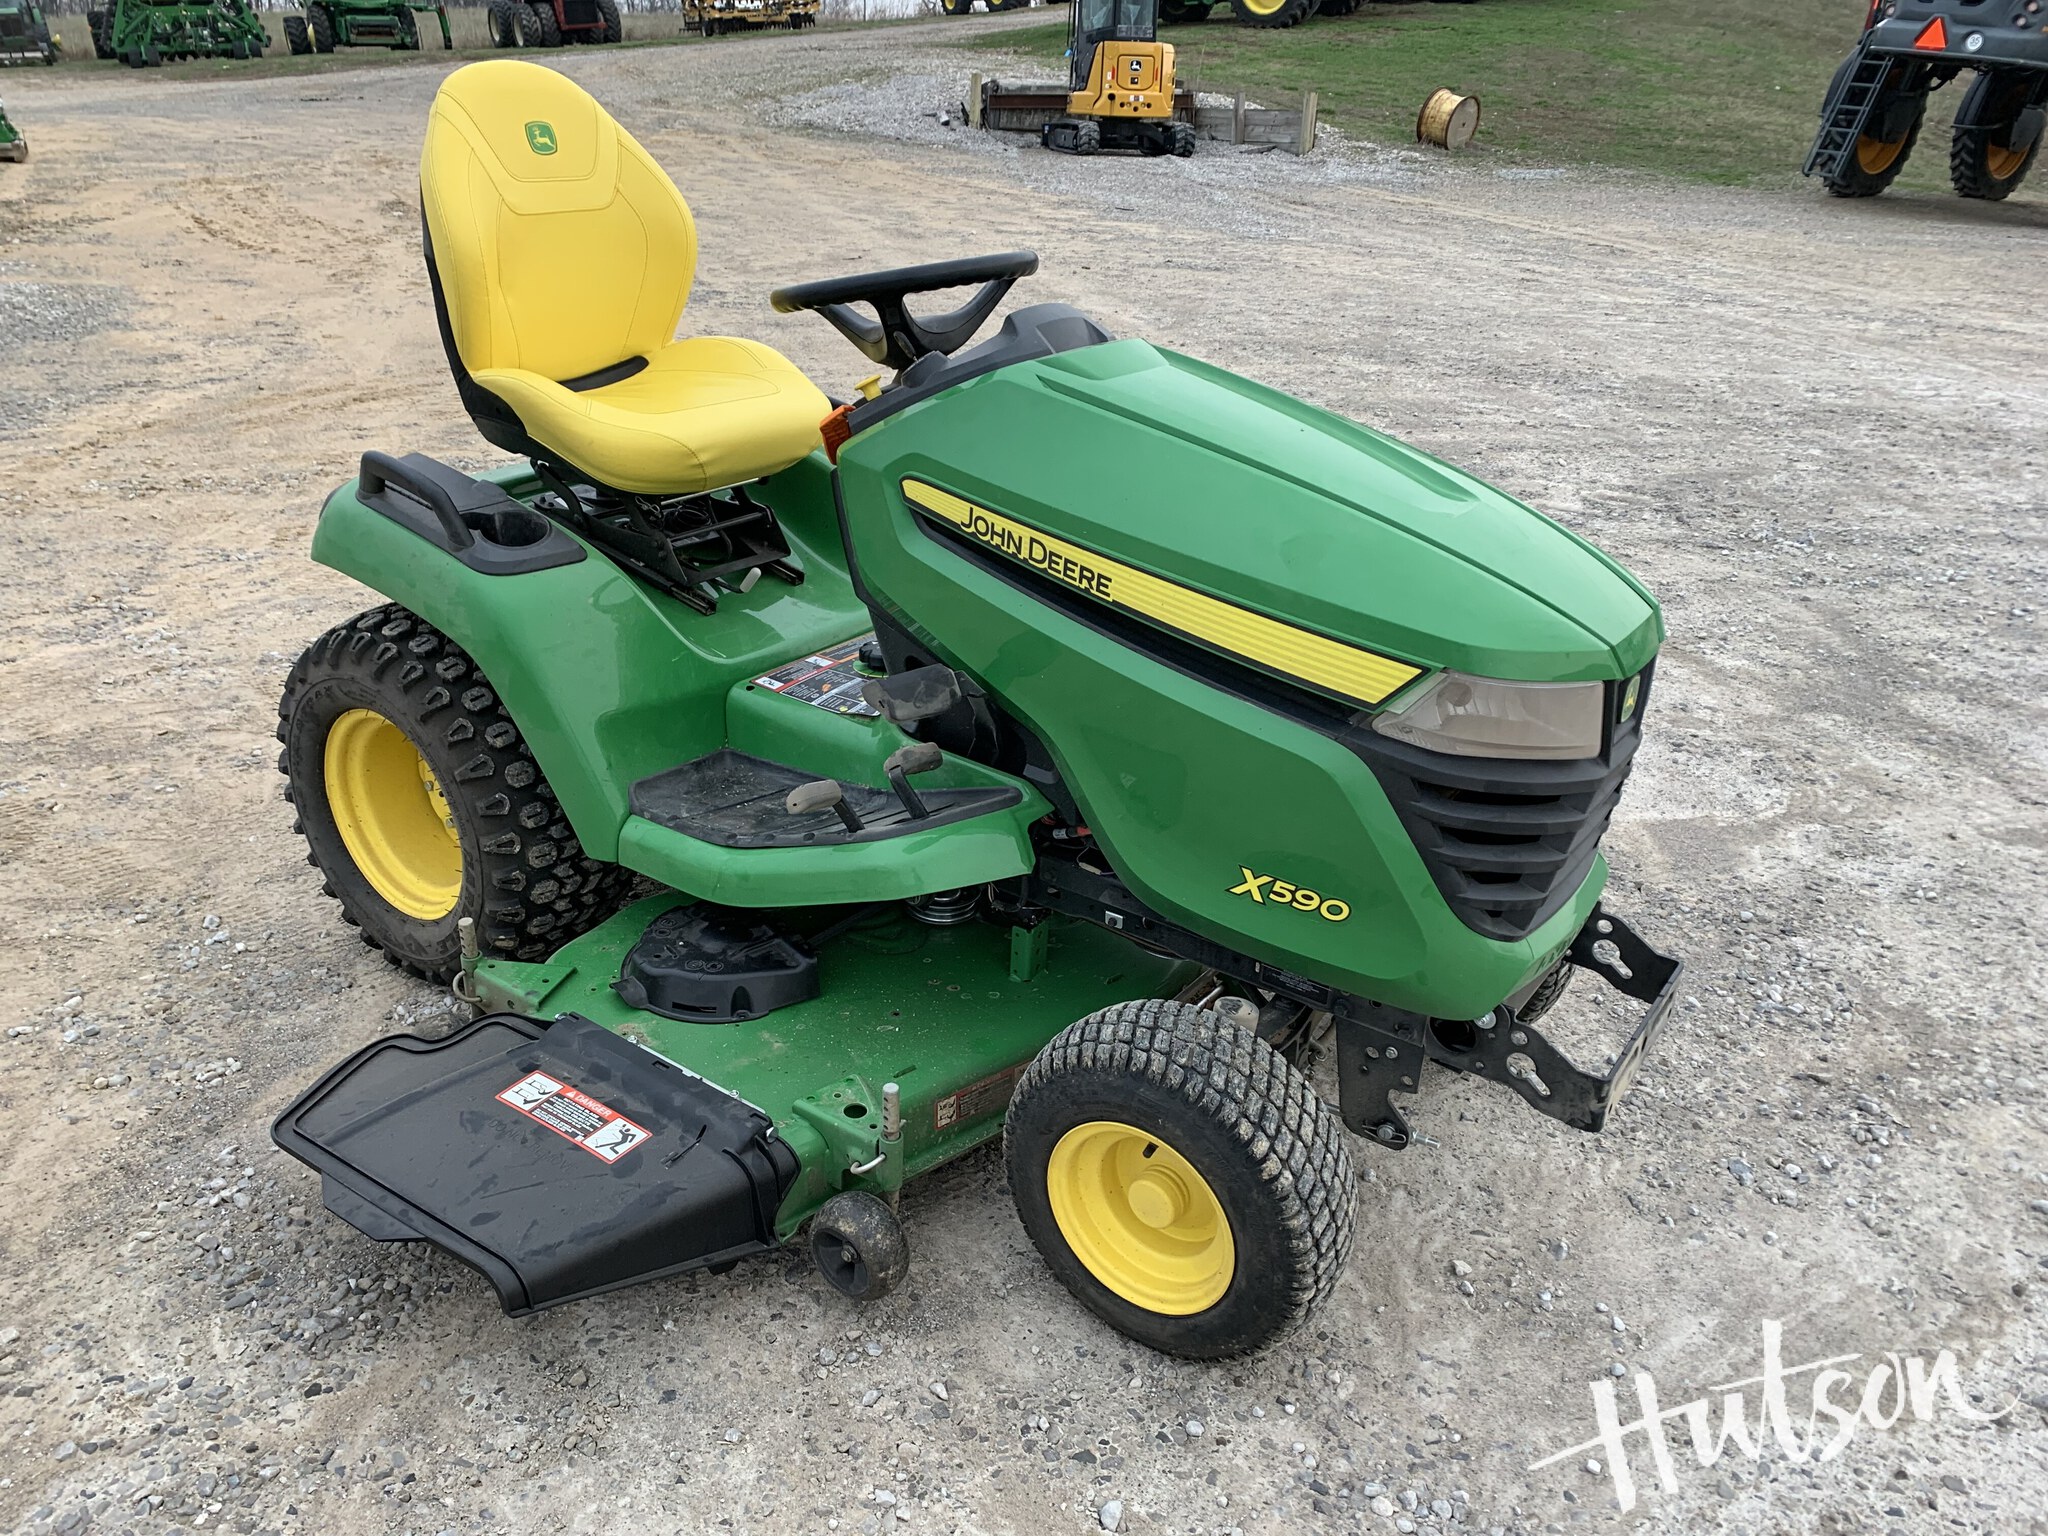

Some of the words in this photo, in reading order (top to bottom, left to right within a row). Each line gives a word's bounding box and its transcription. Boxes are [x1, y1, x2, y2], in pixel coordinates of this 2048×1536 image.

[960, 506, 1023, 556] JOHN
[1028, 536, 1113, 599] DEERE
[1225, 865, 1352, 922] X590
[574, 1094, 612, 1117] DANGER
